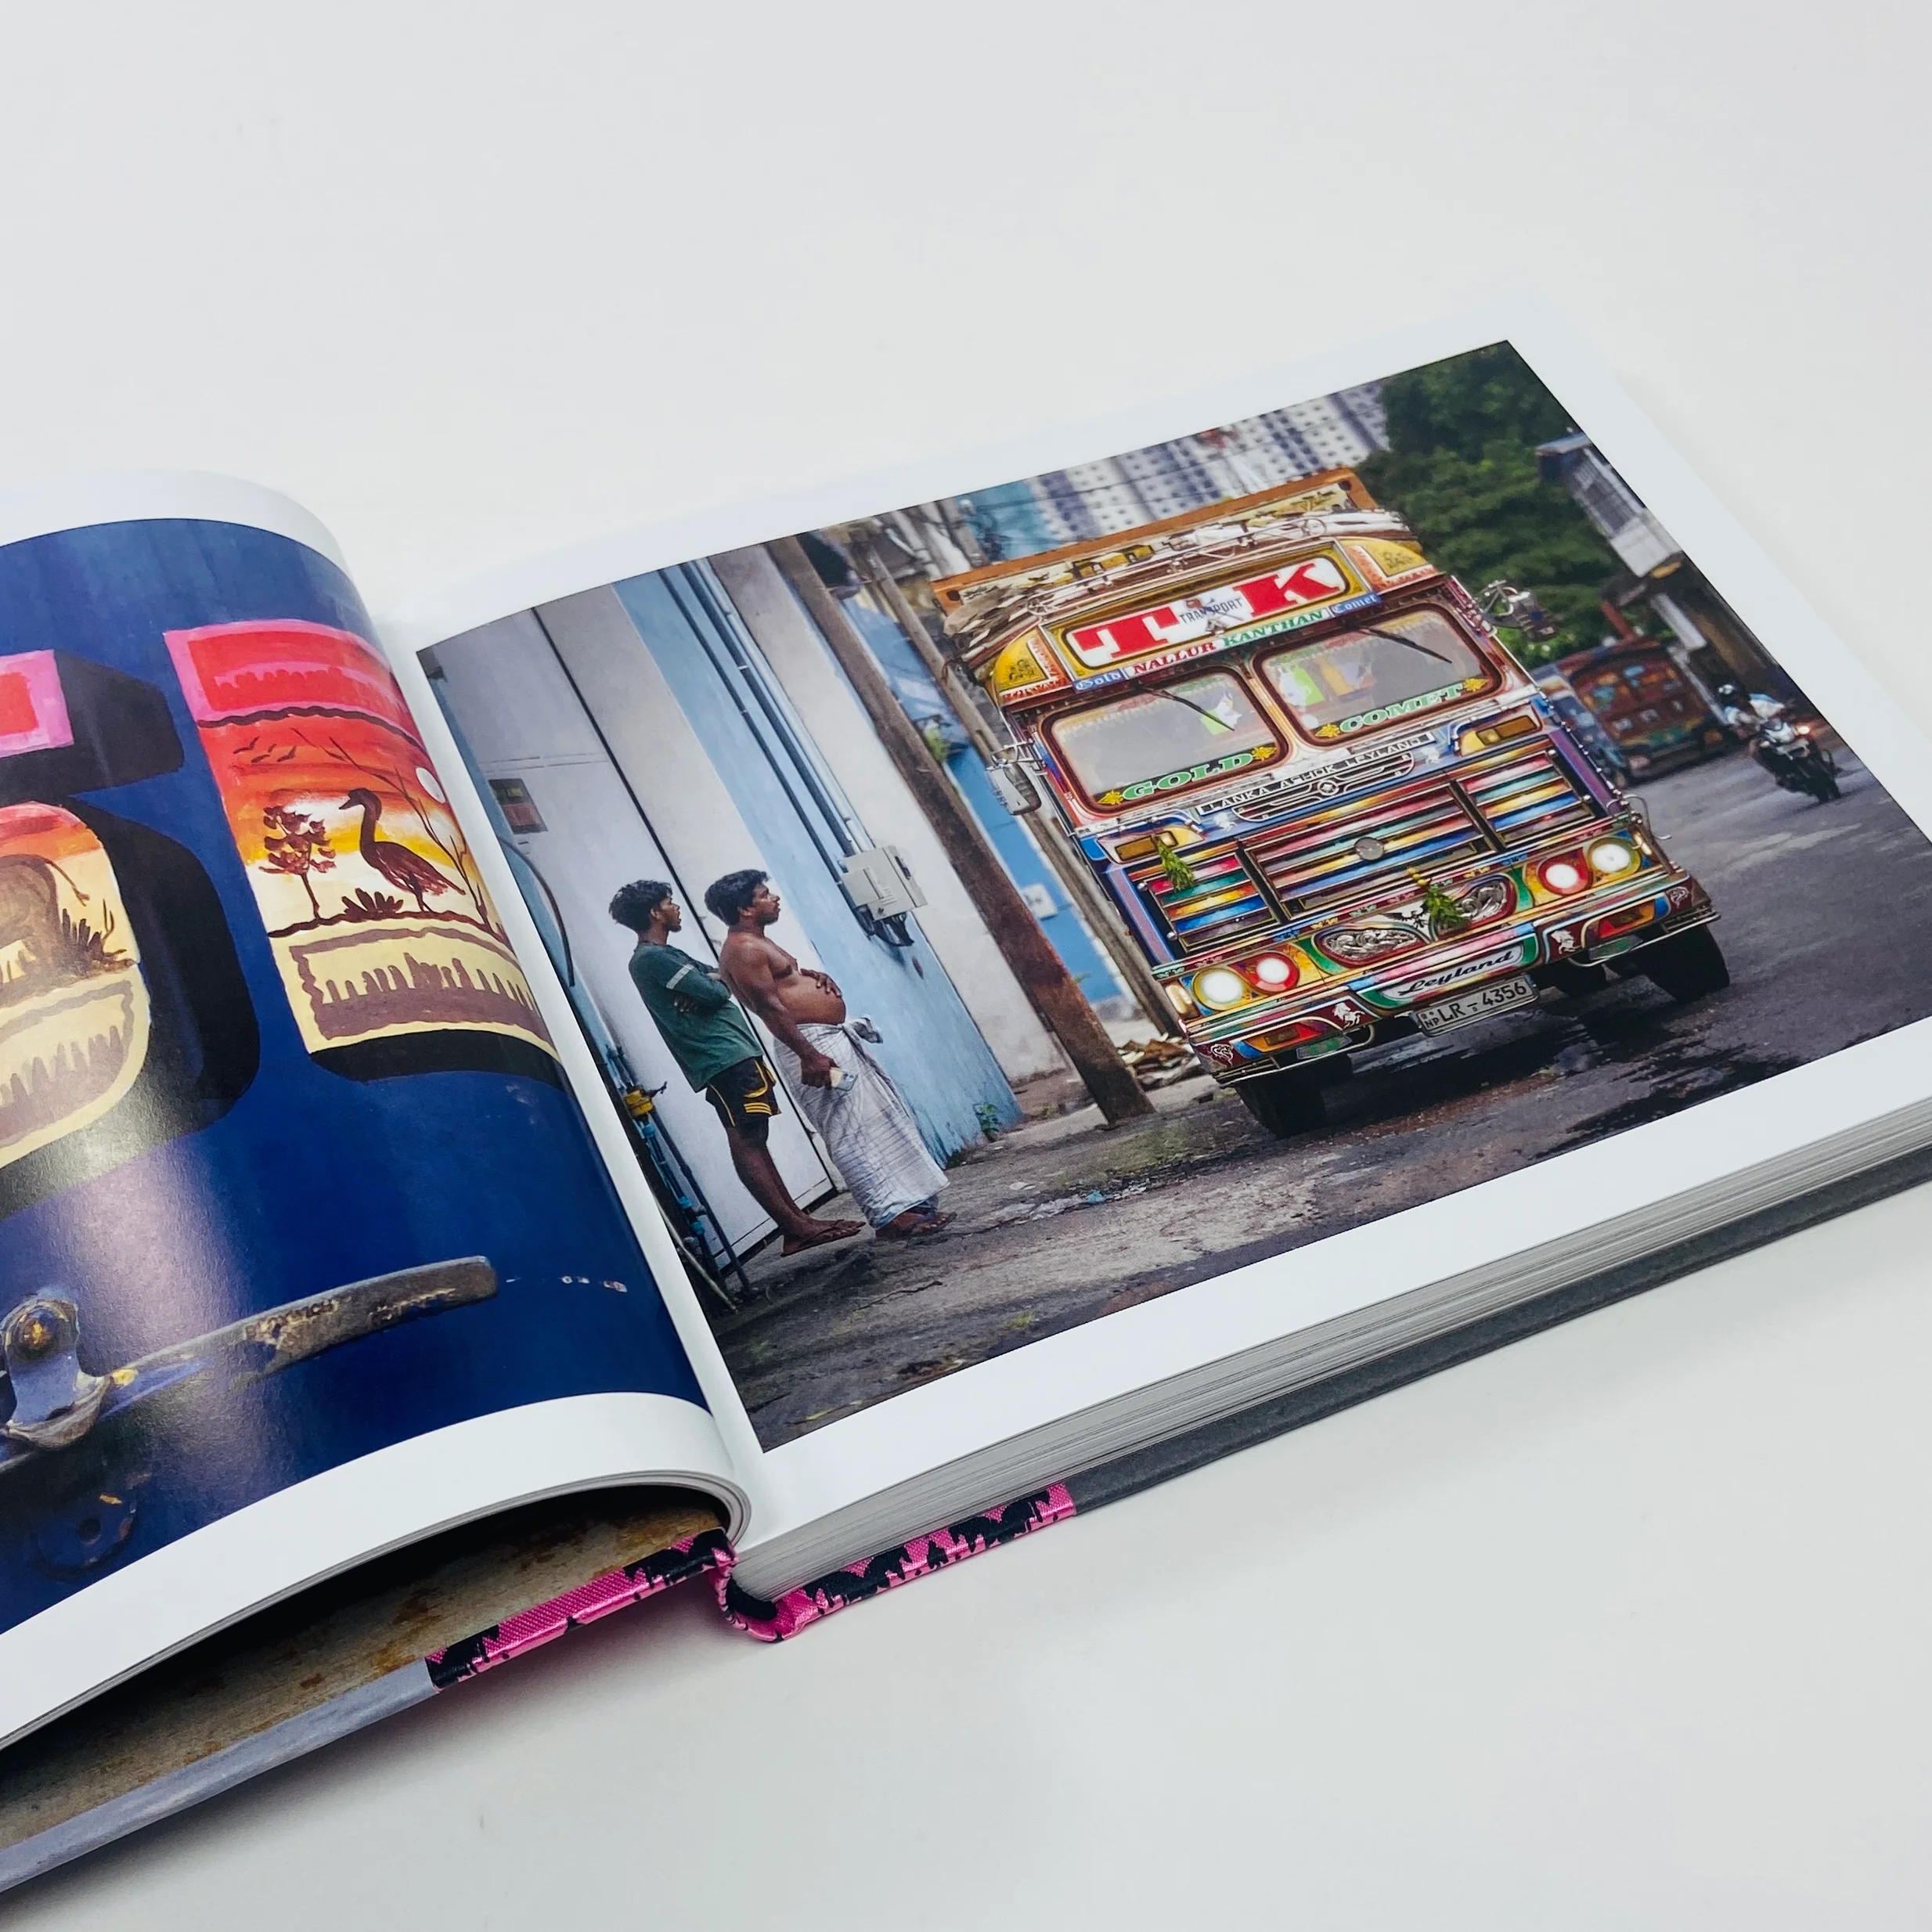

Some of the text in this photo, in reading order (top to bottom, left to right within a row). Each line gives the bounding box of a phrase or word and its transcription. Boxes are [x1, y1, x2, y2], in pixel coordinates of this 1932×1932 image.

[1232, 562, 1341, 618] K
[1076, 595, 1379, 690] Gold NALLUR KANTHAN Comet
[1122, 683, 1463, 800] GOLD COMET
[1209, 788, 1271, 810] LANKA
[1345, 738, 1422, 769] LEYLAND
[1399, 950, 1514, 997] Leyland
